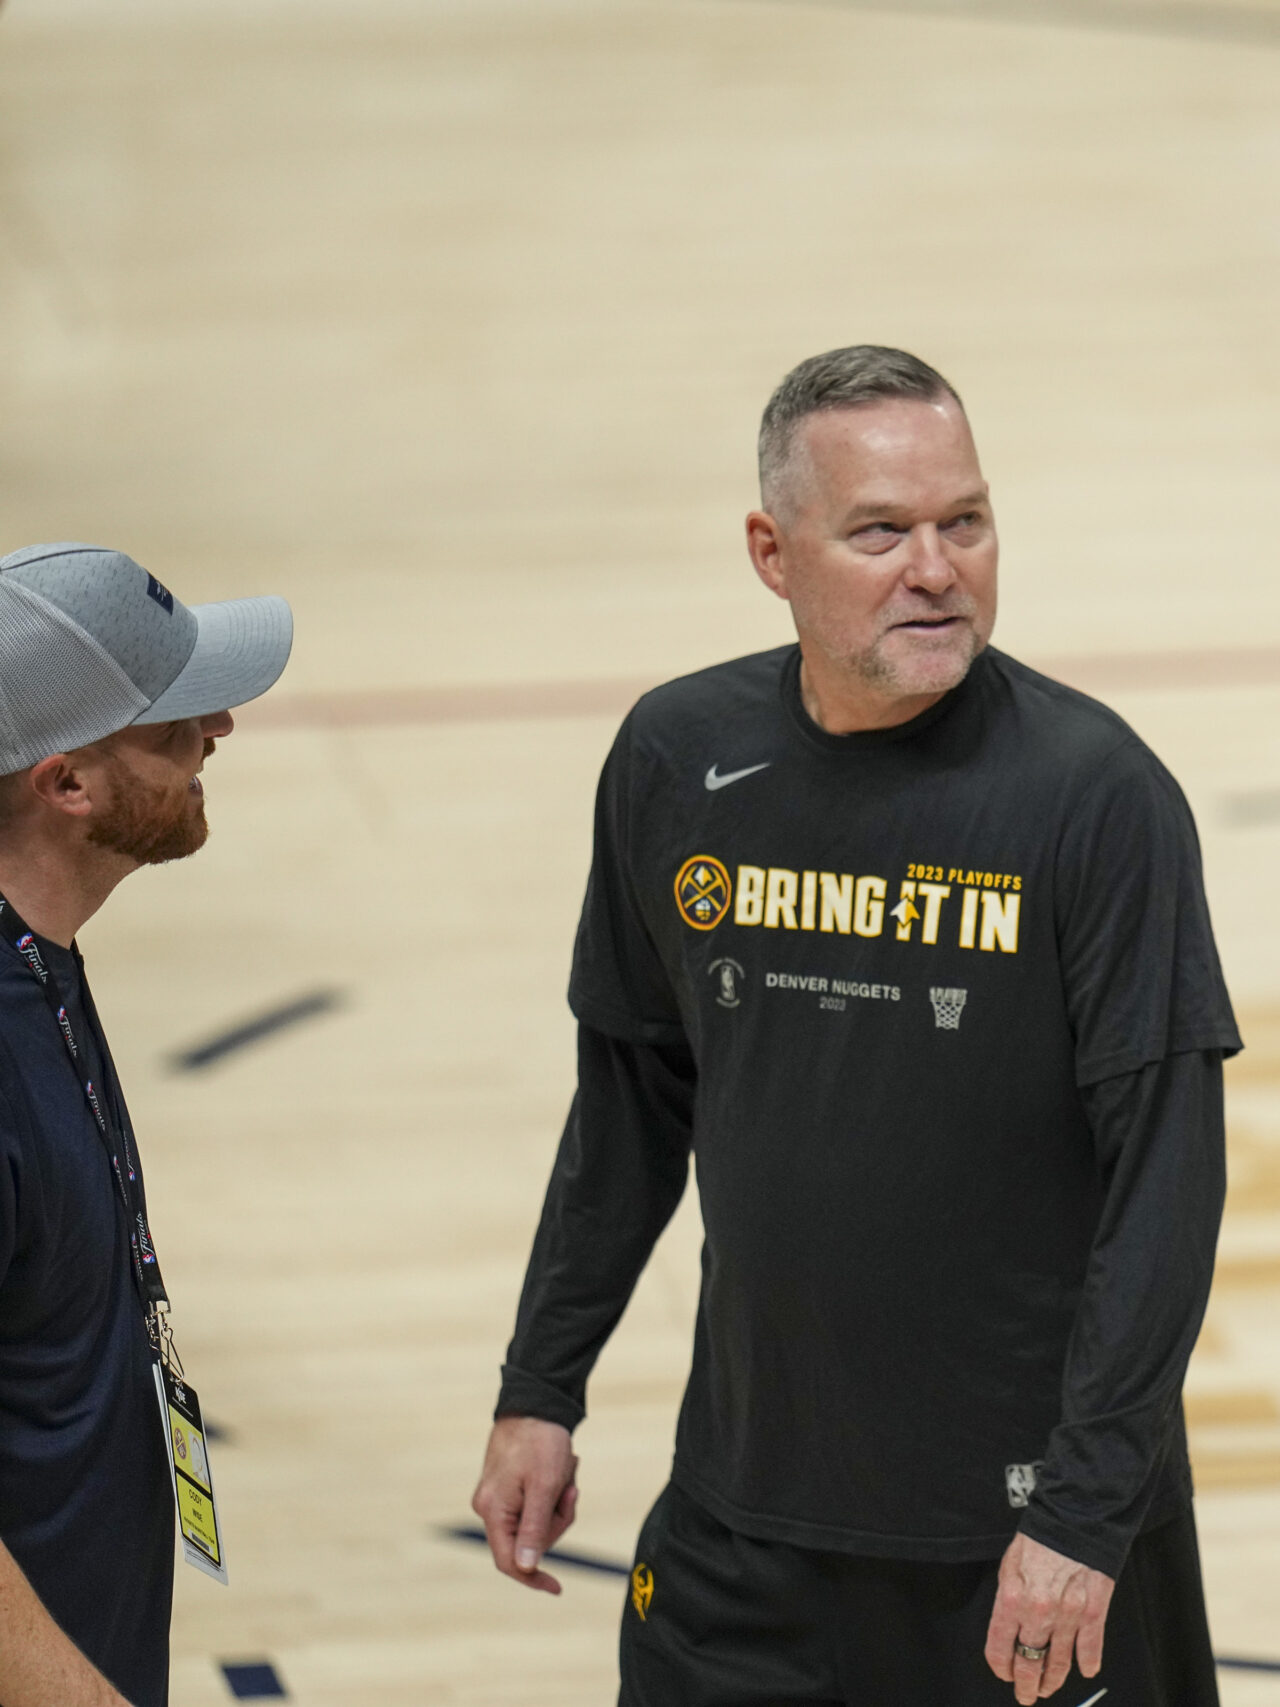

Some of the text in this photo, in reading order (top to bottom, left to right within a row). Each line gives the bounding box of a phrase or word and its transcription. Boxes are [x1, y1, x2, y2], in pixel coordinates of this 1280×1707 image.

[906, 863, 1022, 891] 2023 PLAYOFFS
[734, 864, 1021, 953] BRING IT IN
[765, 972, 901, 1001] DENVER NUGGETS
